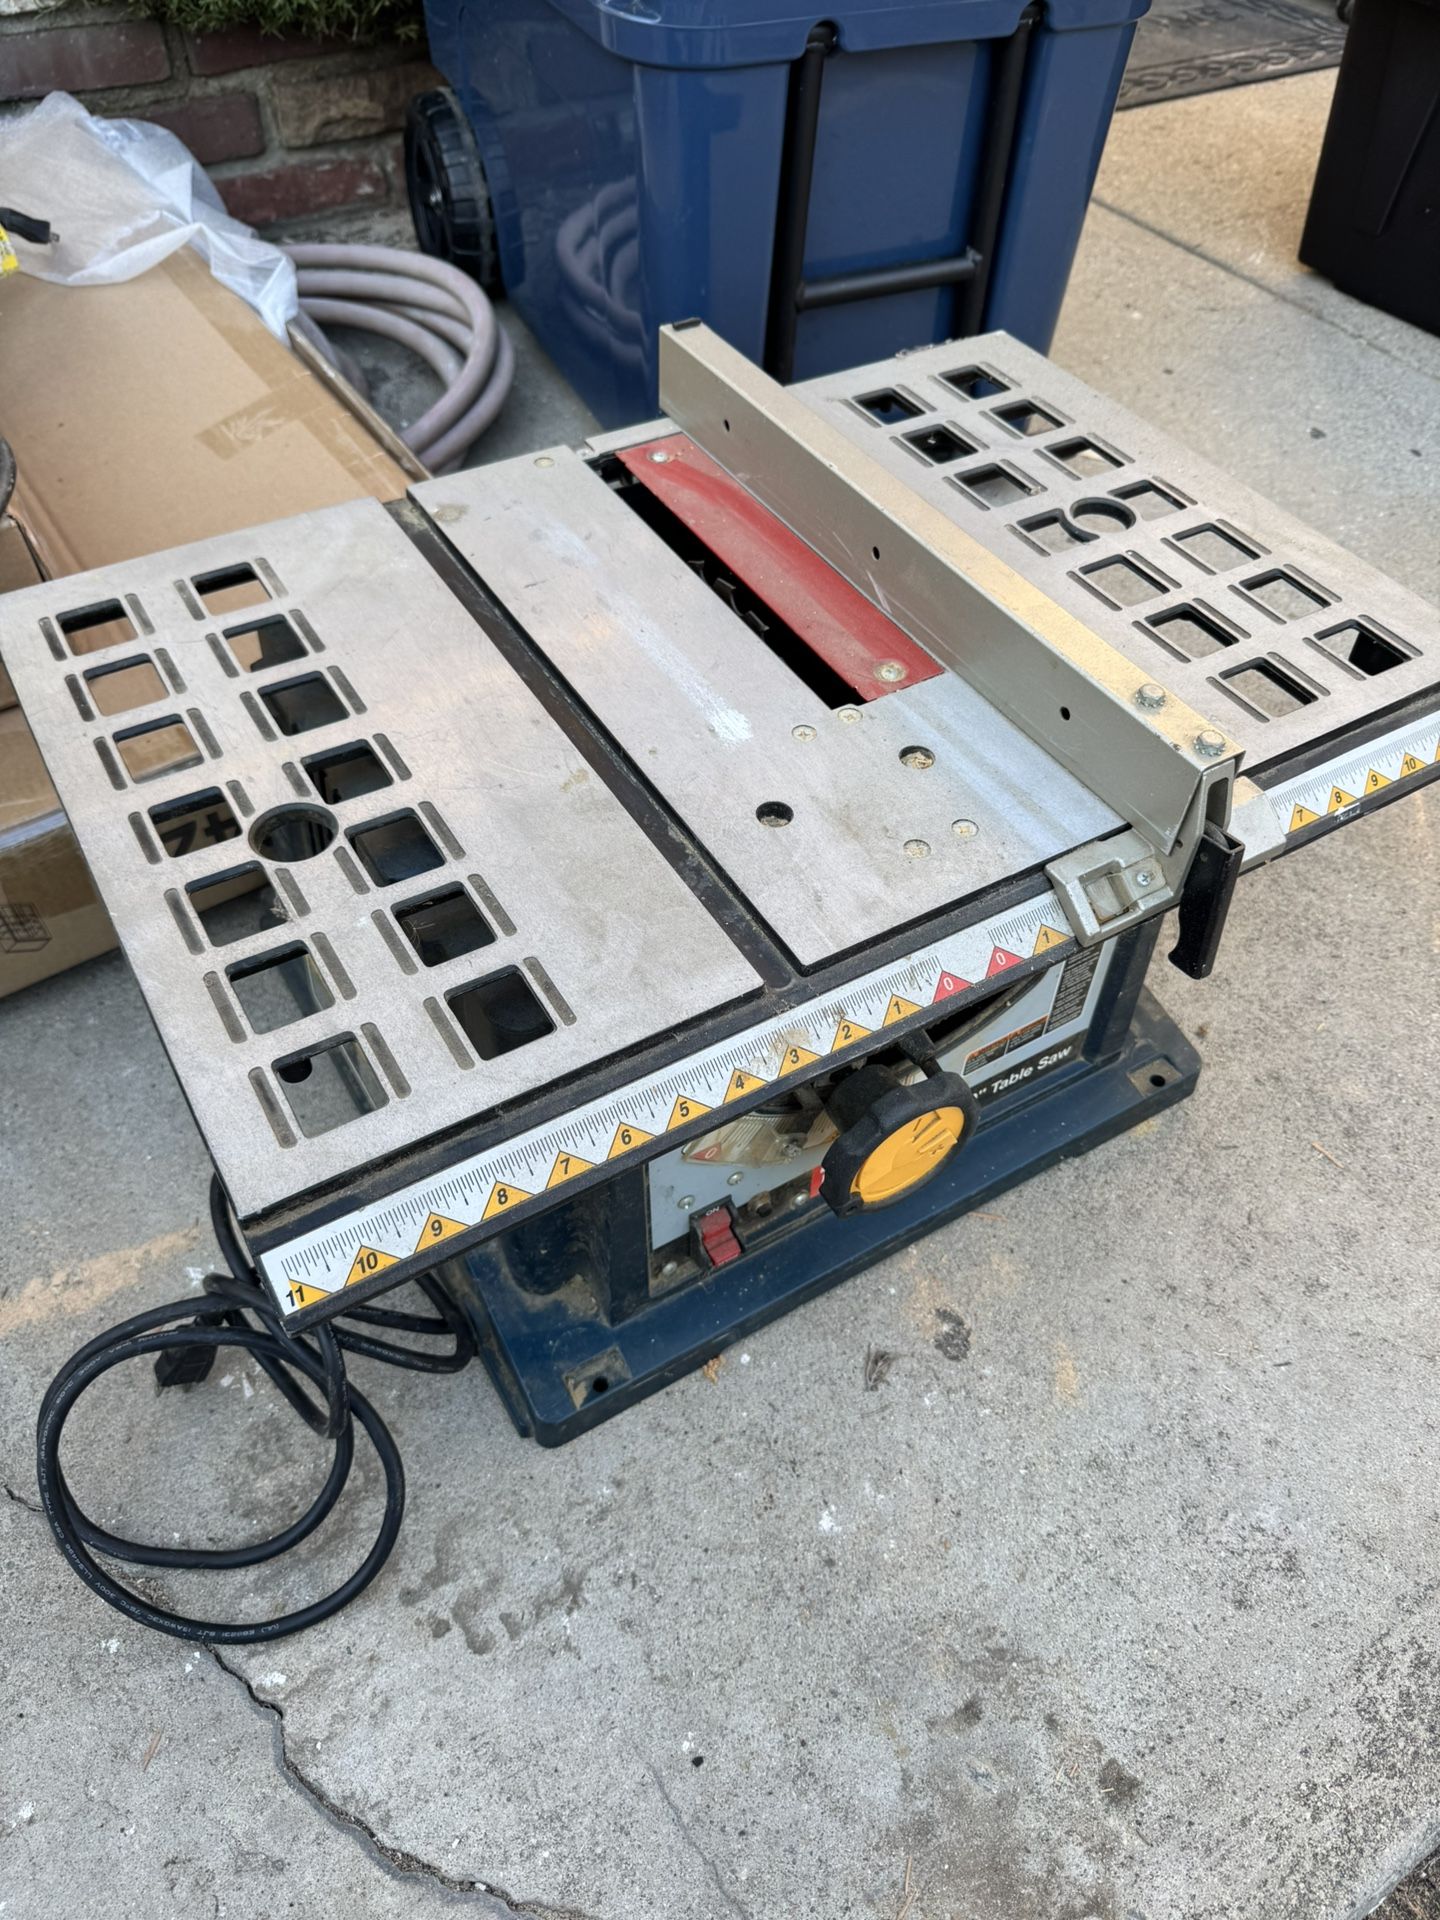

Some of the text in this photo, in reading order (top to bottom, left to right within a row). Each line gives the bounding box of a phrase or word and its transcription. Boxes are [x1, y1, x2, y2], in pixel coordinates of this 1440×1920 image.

[1296, 757, 1416, 822] 7 8 9 10
[991, 1066, 1034, 1094] Table
[1037, 1045, 1073, 1070] Saw
[286, 930, 1050, 1307] 11 10 9 8 7 6 5 4 3 2 1 0 0 1
[705, 1206, 720, 1217] ON
